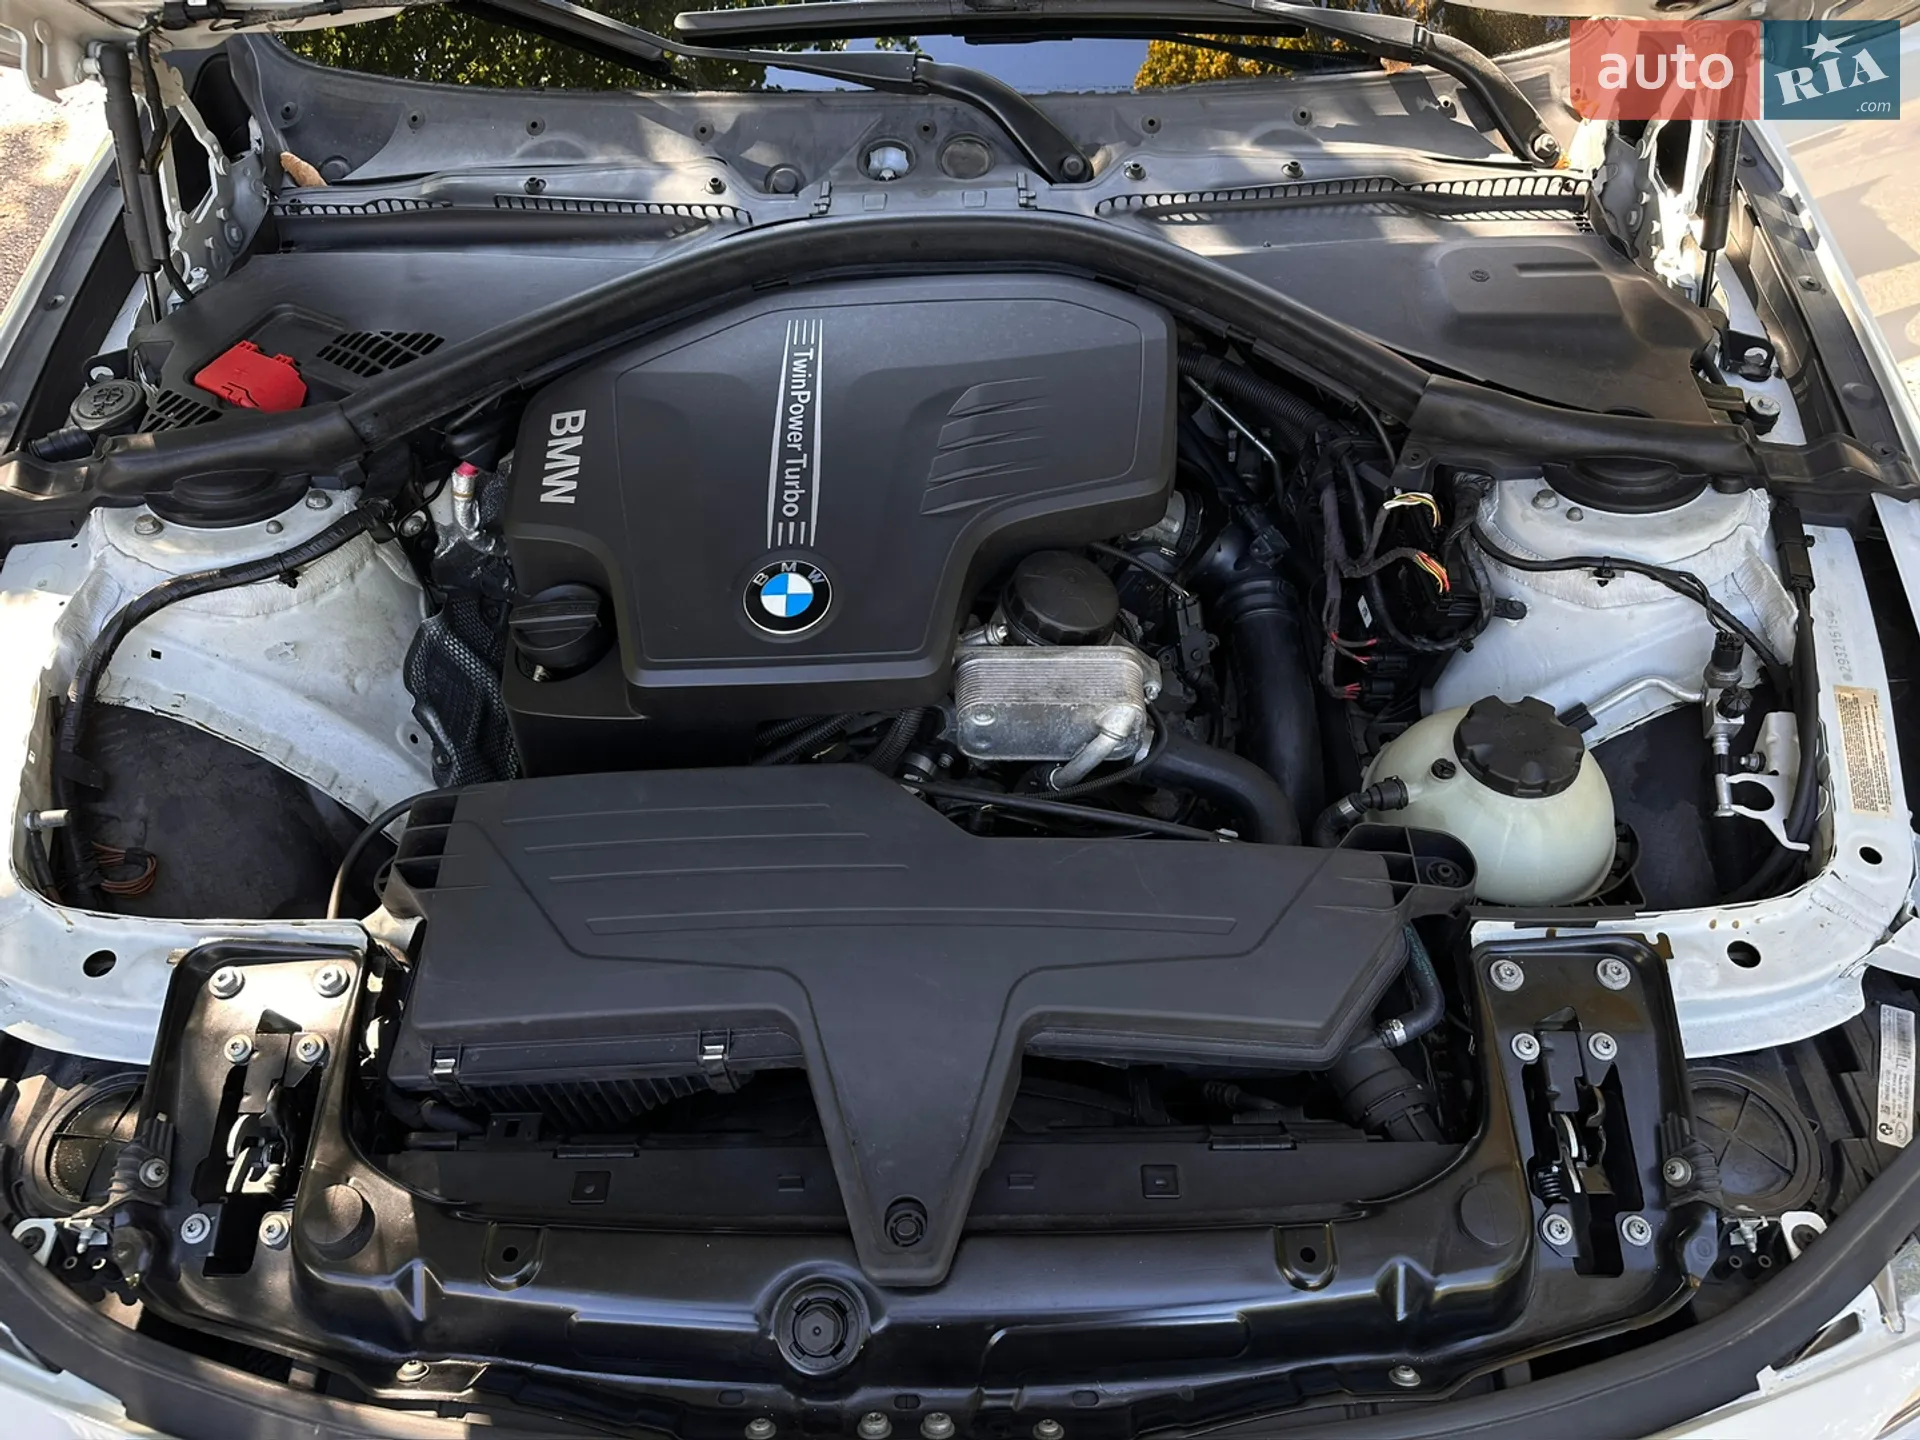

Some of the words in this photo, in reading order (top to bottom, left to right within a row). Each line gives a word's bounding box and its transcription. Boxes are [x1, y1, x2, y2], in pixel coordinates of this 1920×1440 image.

[787, 348, 814, 451] TwinPower
[540, 409, 586, 503] BMW
[782, 453, 807, 517] Turbo
[753, 562, 825, 584] BMW
